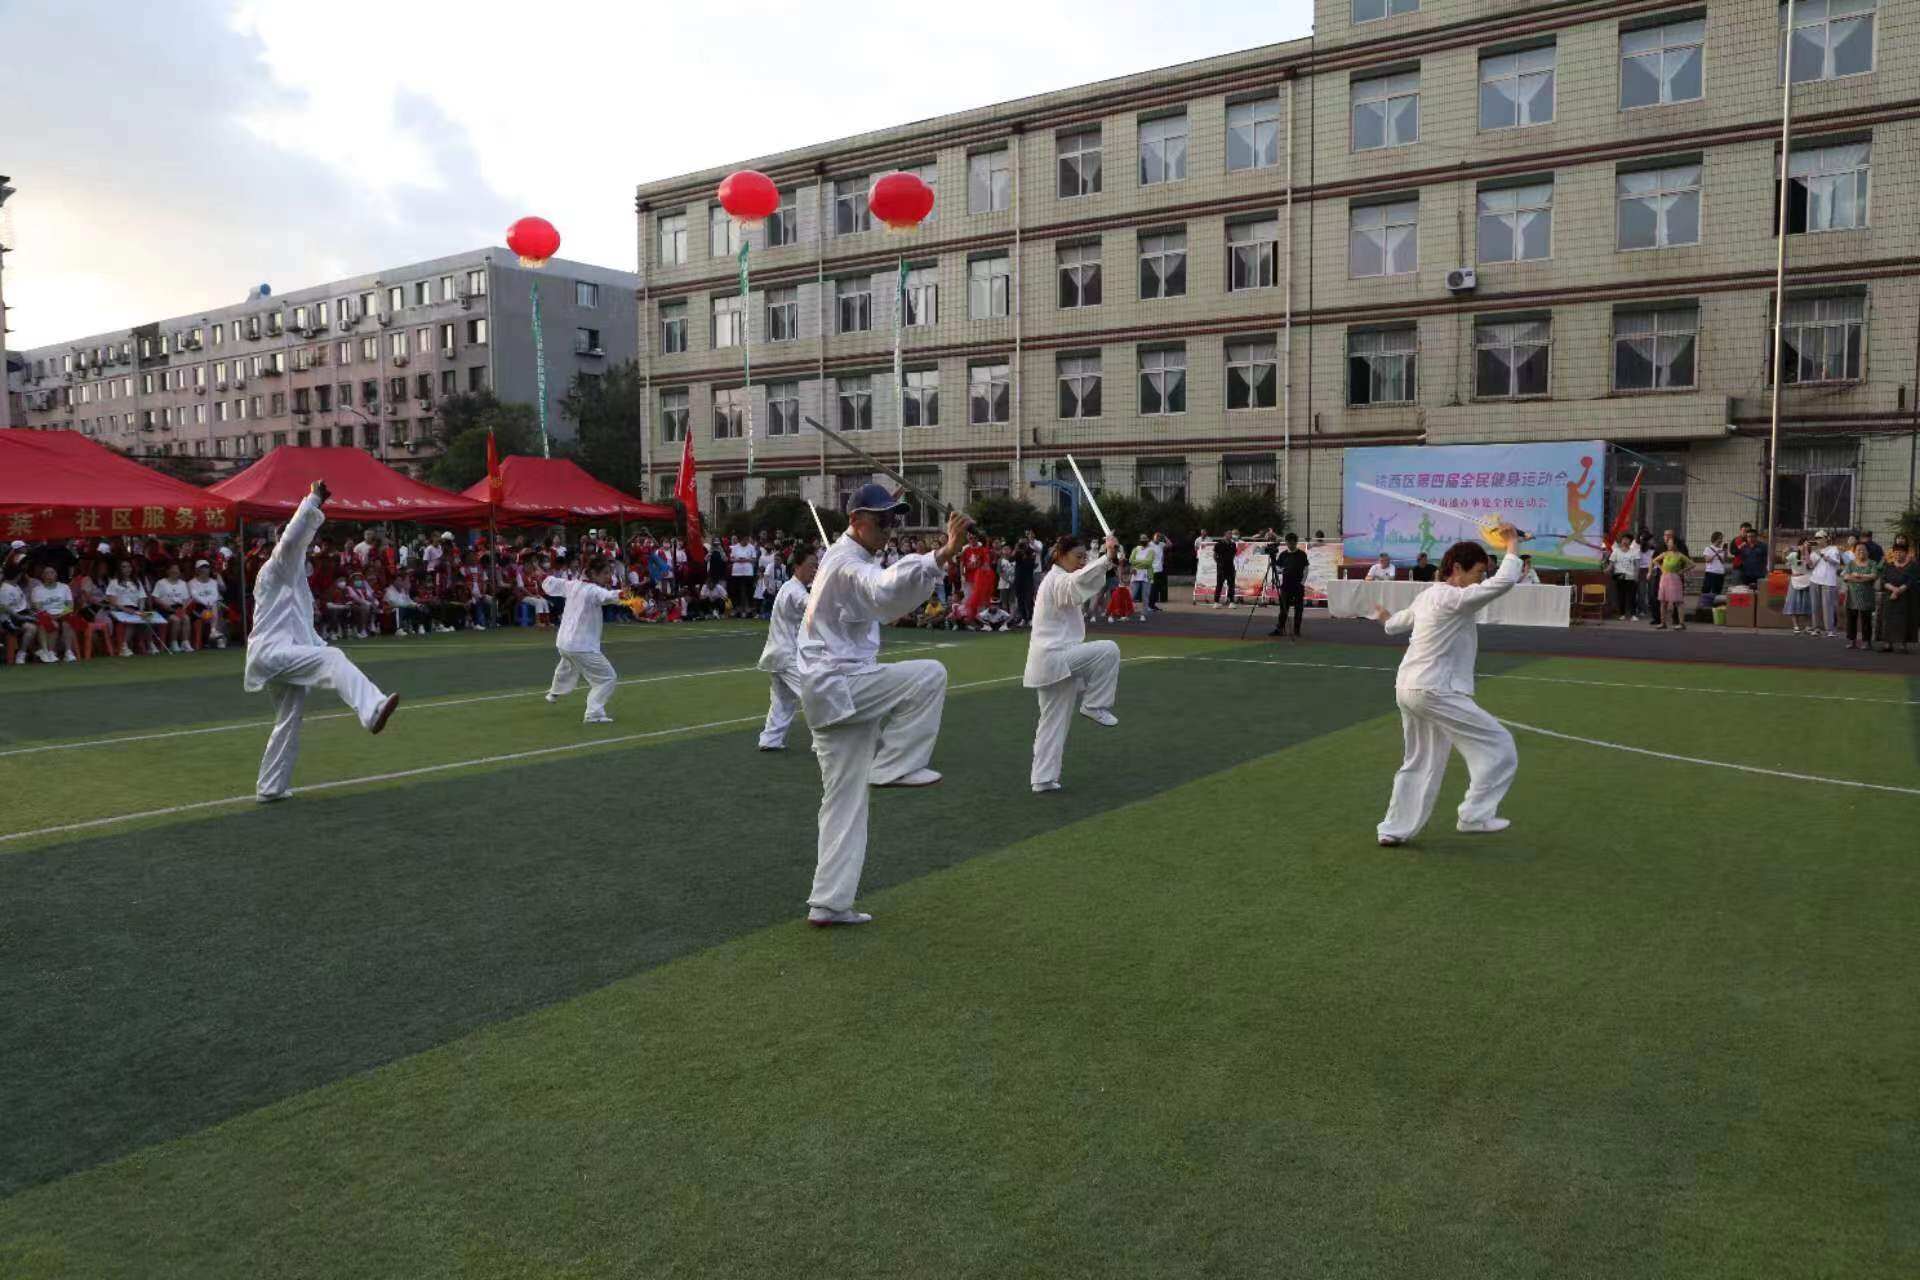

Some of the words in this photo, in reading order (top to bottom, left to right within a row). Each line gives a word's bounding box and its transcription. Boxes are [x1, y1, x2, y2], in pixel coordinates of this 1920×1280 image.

[76, 505, 226, 532] 社区服务站
